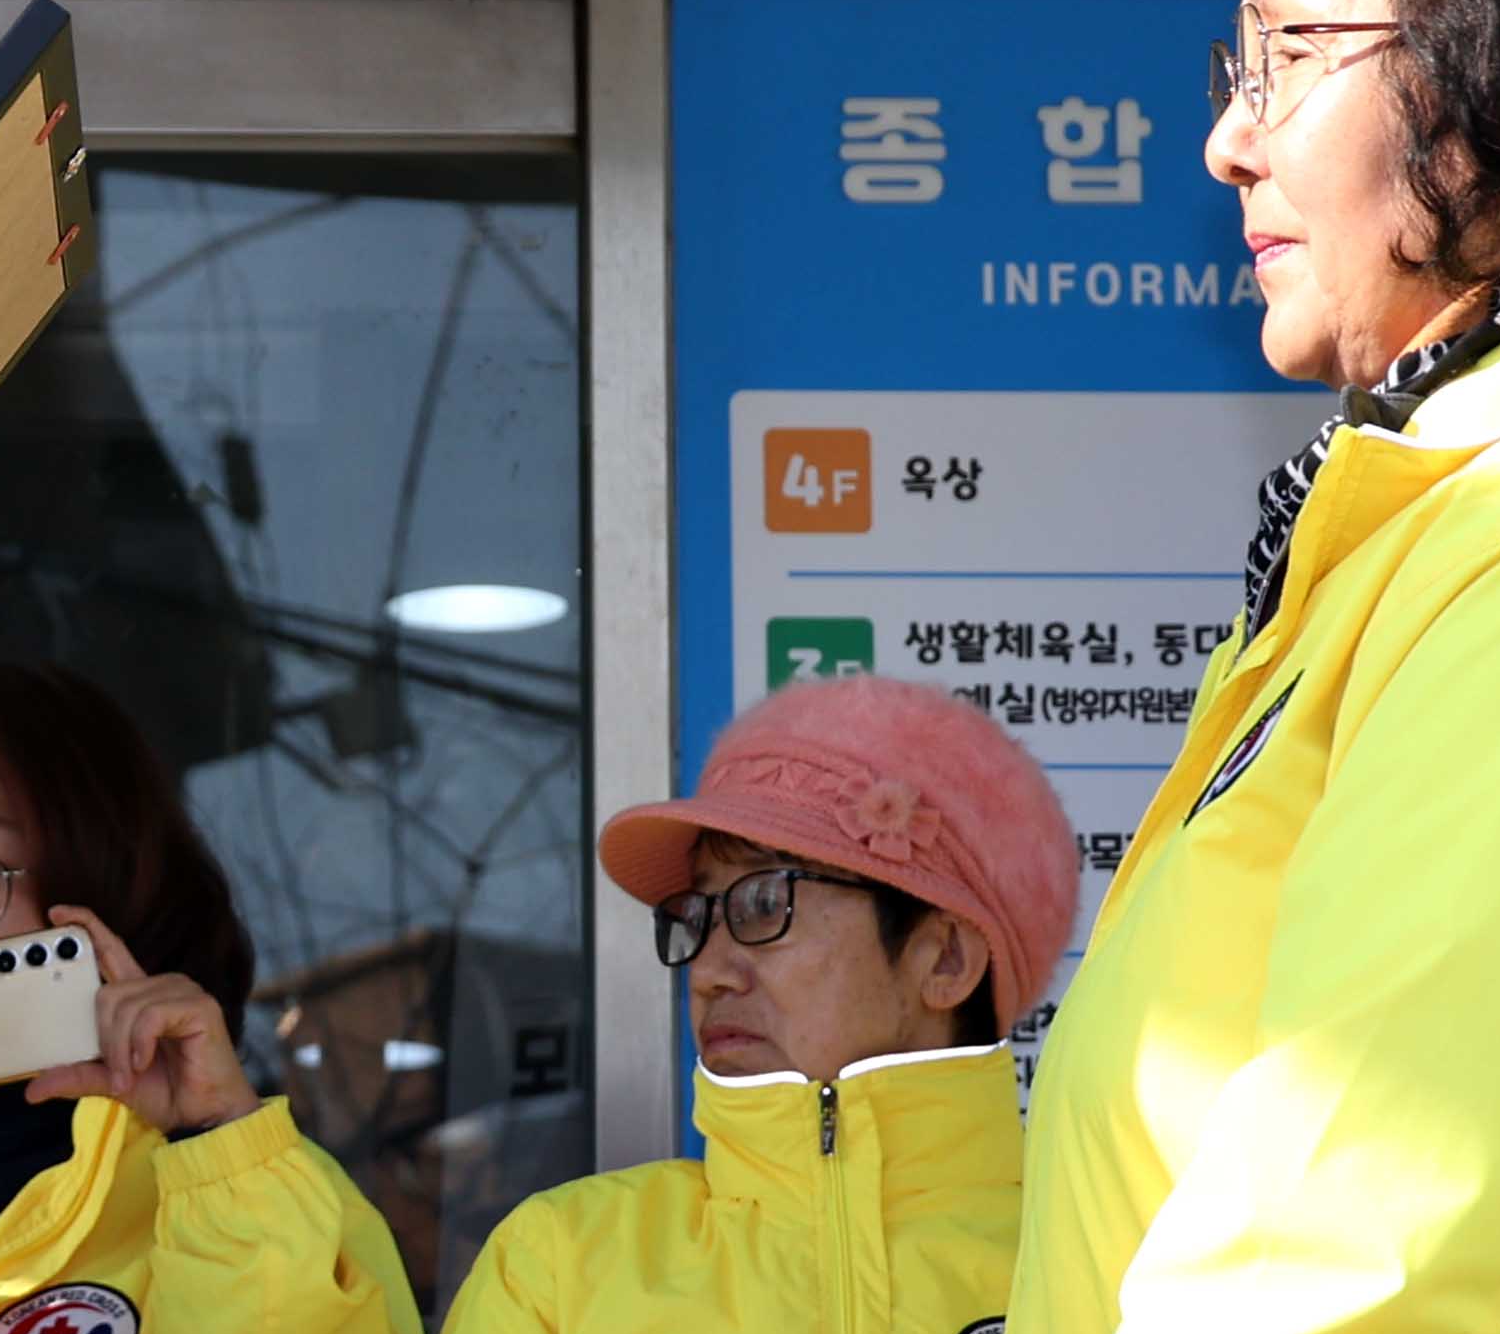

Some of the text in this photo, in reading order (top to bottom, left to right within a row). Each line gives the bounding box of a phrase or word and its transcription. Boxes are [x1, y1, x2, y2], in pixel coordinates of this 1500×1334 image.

[780, 454, 860, 507] 4F
[902, 458, 983, 500] 옥상
[906, 621, 1133, 665] 생활체육실,
